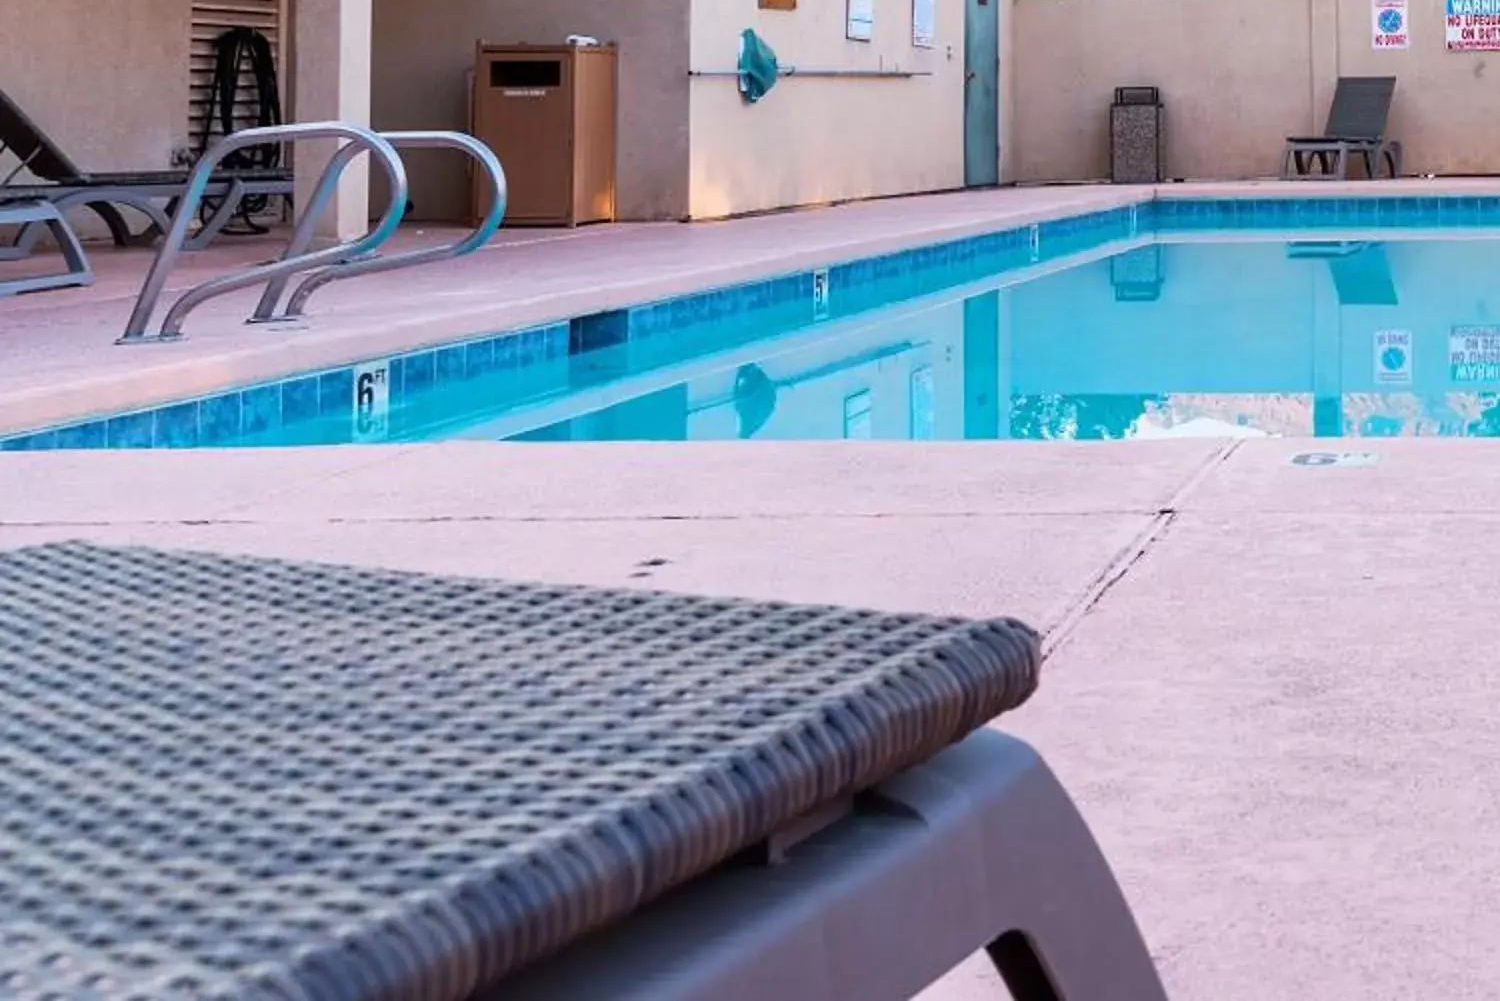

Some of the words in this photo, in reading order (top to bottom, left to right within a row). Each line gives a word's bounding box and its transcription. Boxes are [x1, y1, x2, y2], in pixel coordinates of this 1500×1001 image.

[1448, 14, 1460, 27] NO
[1462, 27, 1475, 40] ON
[358, 373, 373, 411] 6
